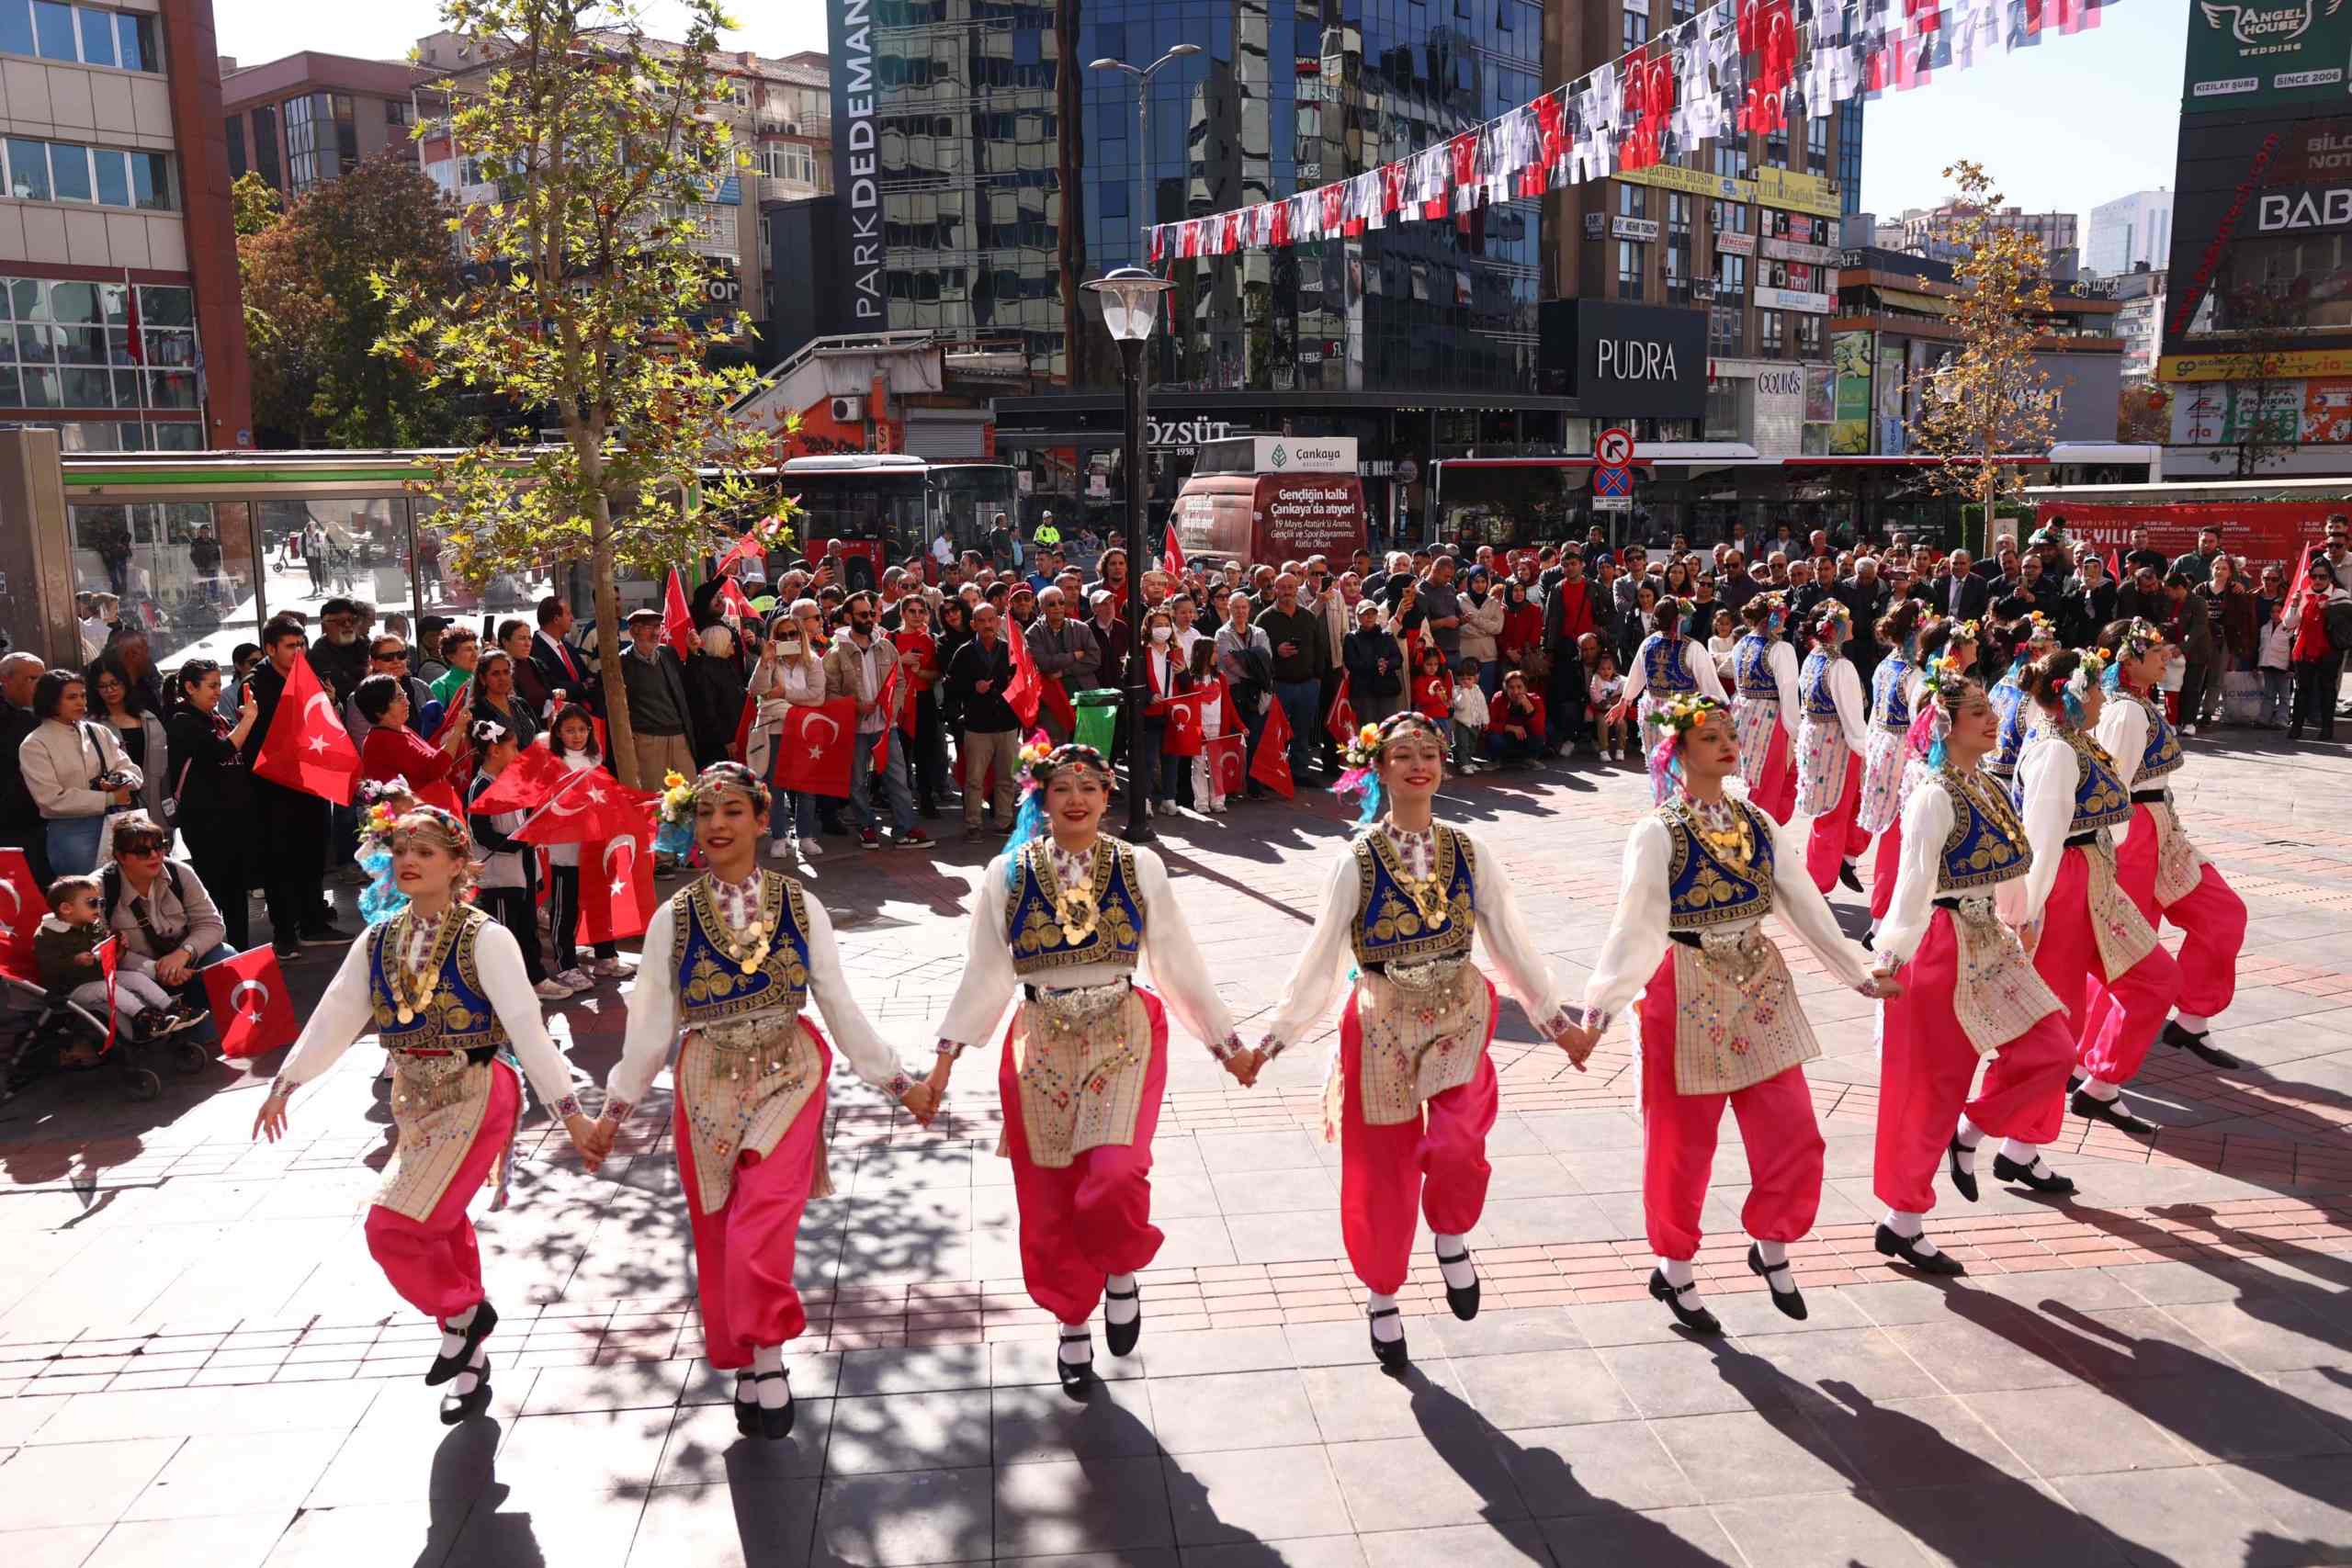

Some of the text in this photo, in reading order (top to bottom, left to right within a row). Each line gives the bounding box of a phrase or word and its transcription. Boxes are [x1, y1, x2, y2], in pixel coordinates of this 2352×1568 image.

[2240, 8, 2306, 25] ANGEL
[2245, 20, 2299, 35] HOUSE
[2239, 43, 2301, 57] WEDDING
[2312, 71, 2340, 83] 2006
[1839, 254, 1861, 267] AFE
[1599, 339, 1678, 381] PUDRA
[1176, 447, 1194, 456] 1938
[1296, 447, 1340, 462] Çankaya
[1279, 488, 1348, 503] Gençliğin kalbi
[1271, 502, 1324, 518] Çankaya'da
[1275, 520, 1283, 528] 19
[1304, 530, 1319, 539] Spor
